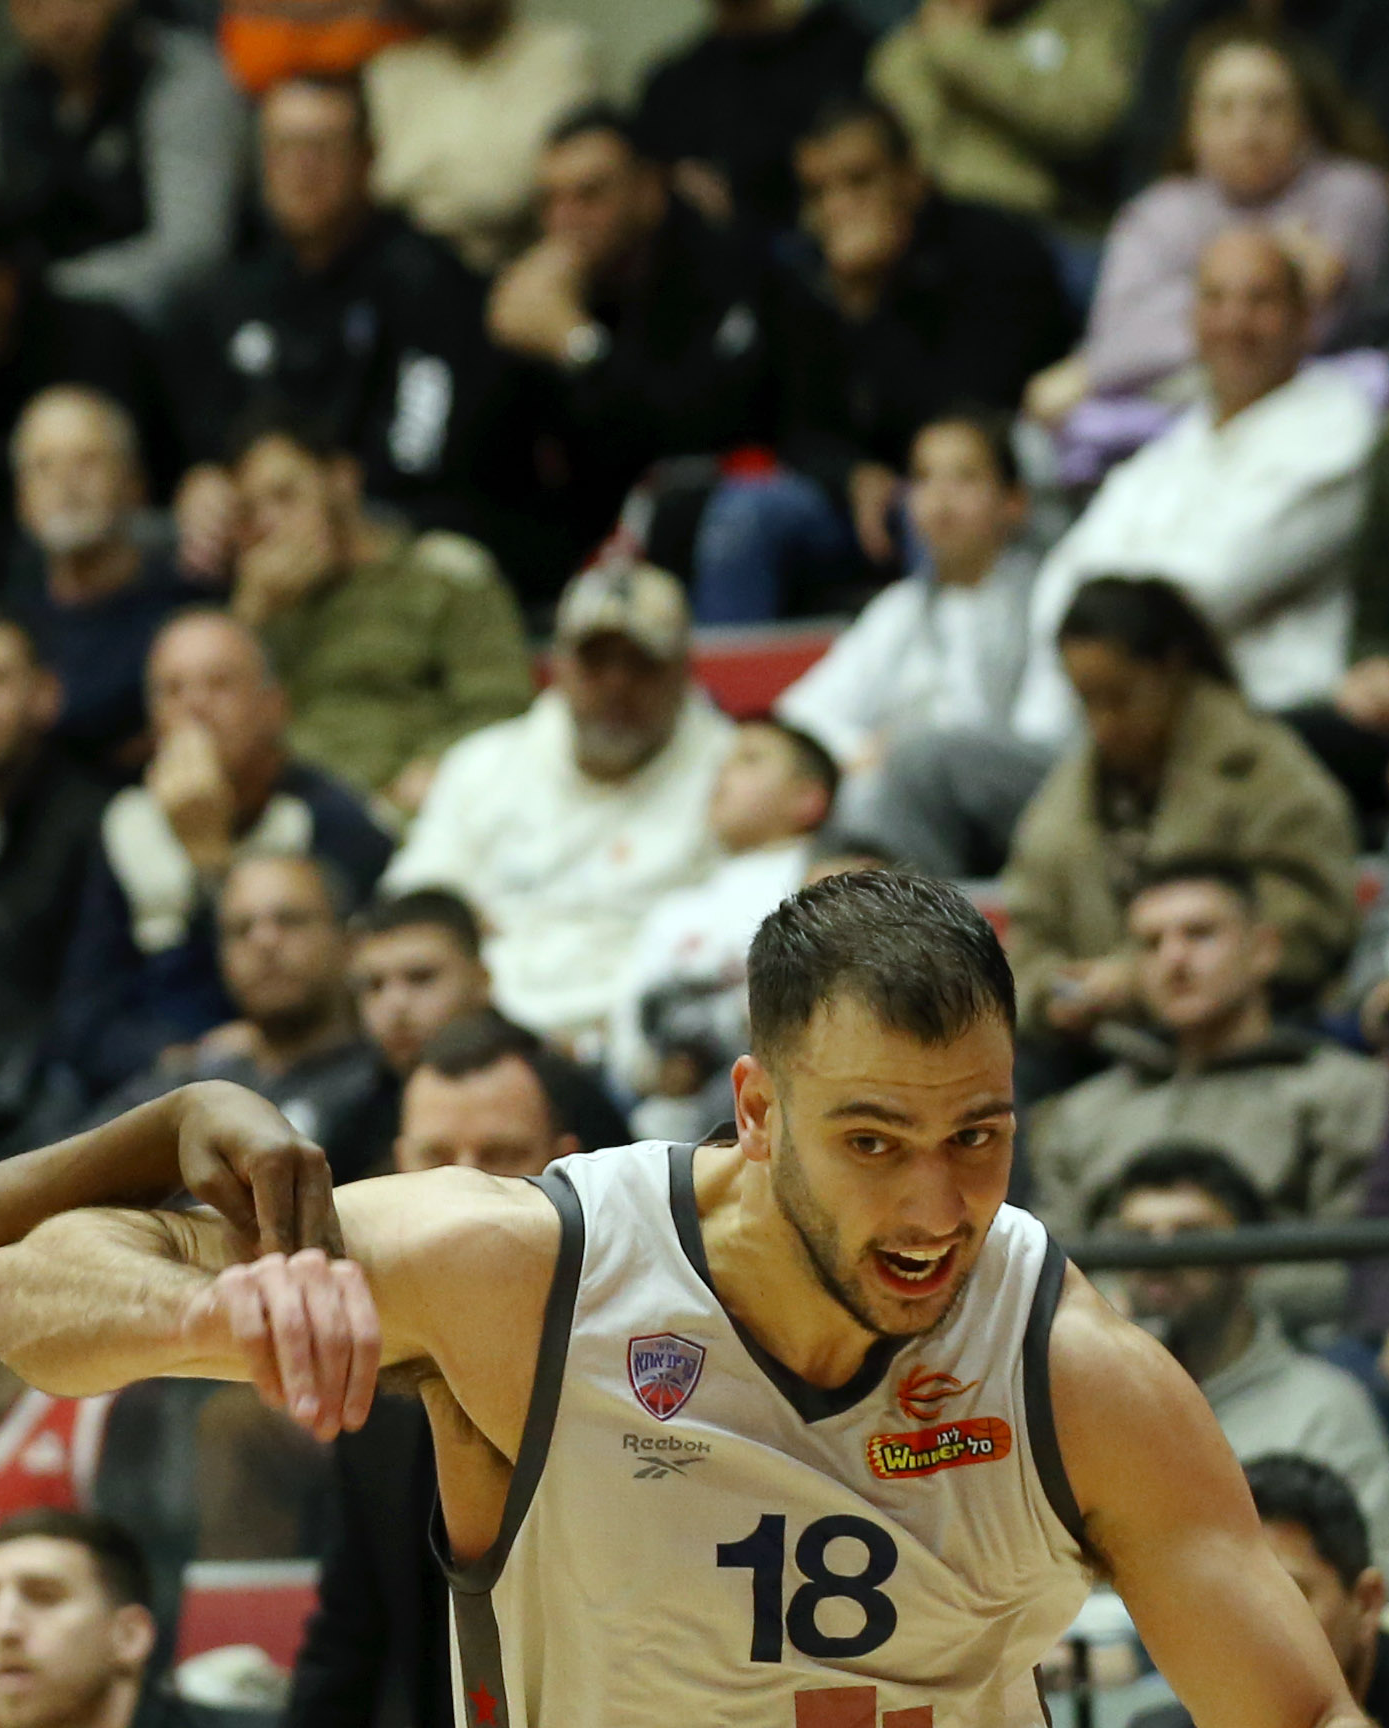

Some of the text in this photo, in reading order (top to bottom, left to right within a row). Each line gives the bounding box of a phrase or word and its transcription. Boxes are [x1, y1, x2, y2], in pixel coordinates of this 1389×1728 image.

[622, 1433, 711, 1454] Reebok
[882, 1436, 993, 1470] Winner סל
[717, 1513, 898, 1664] 18
